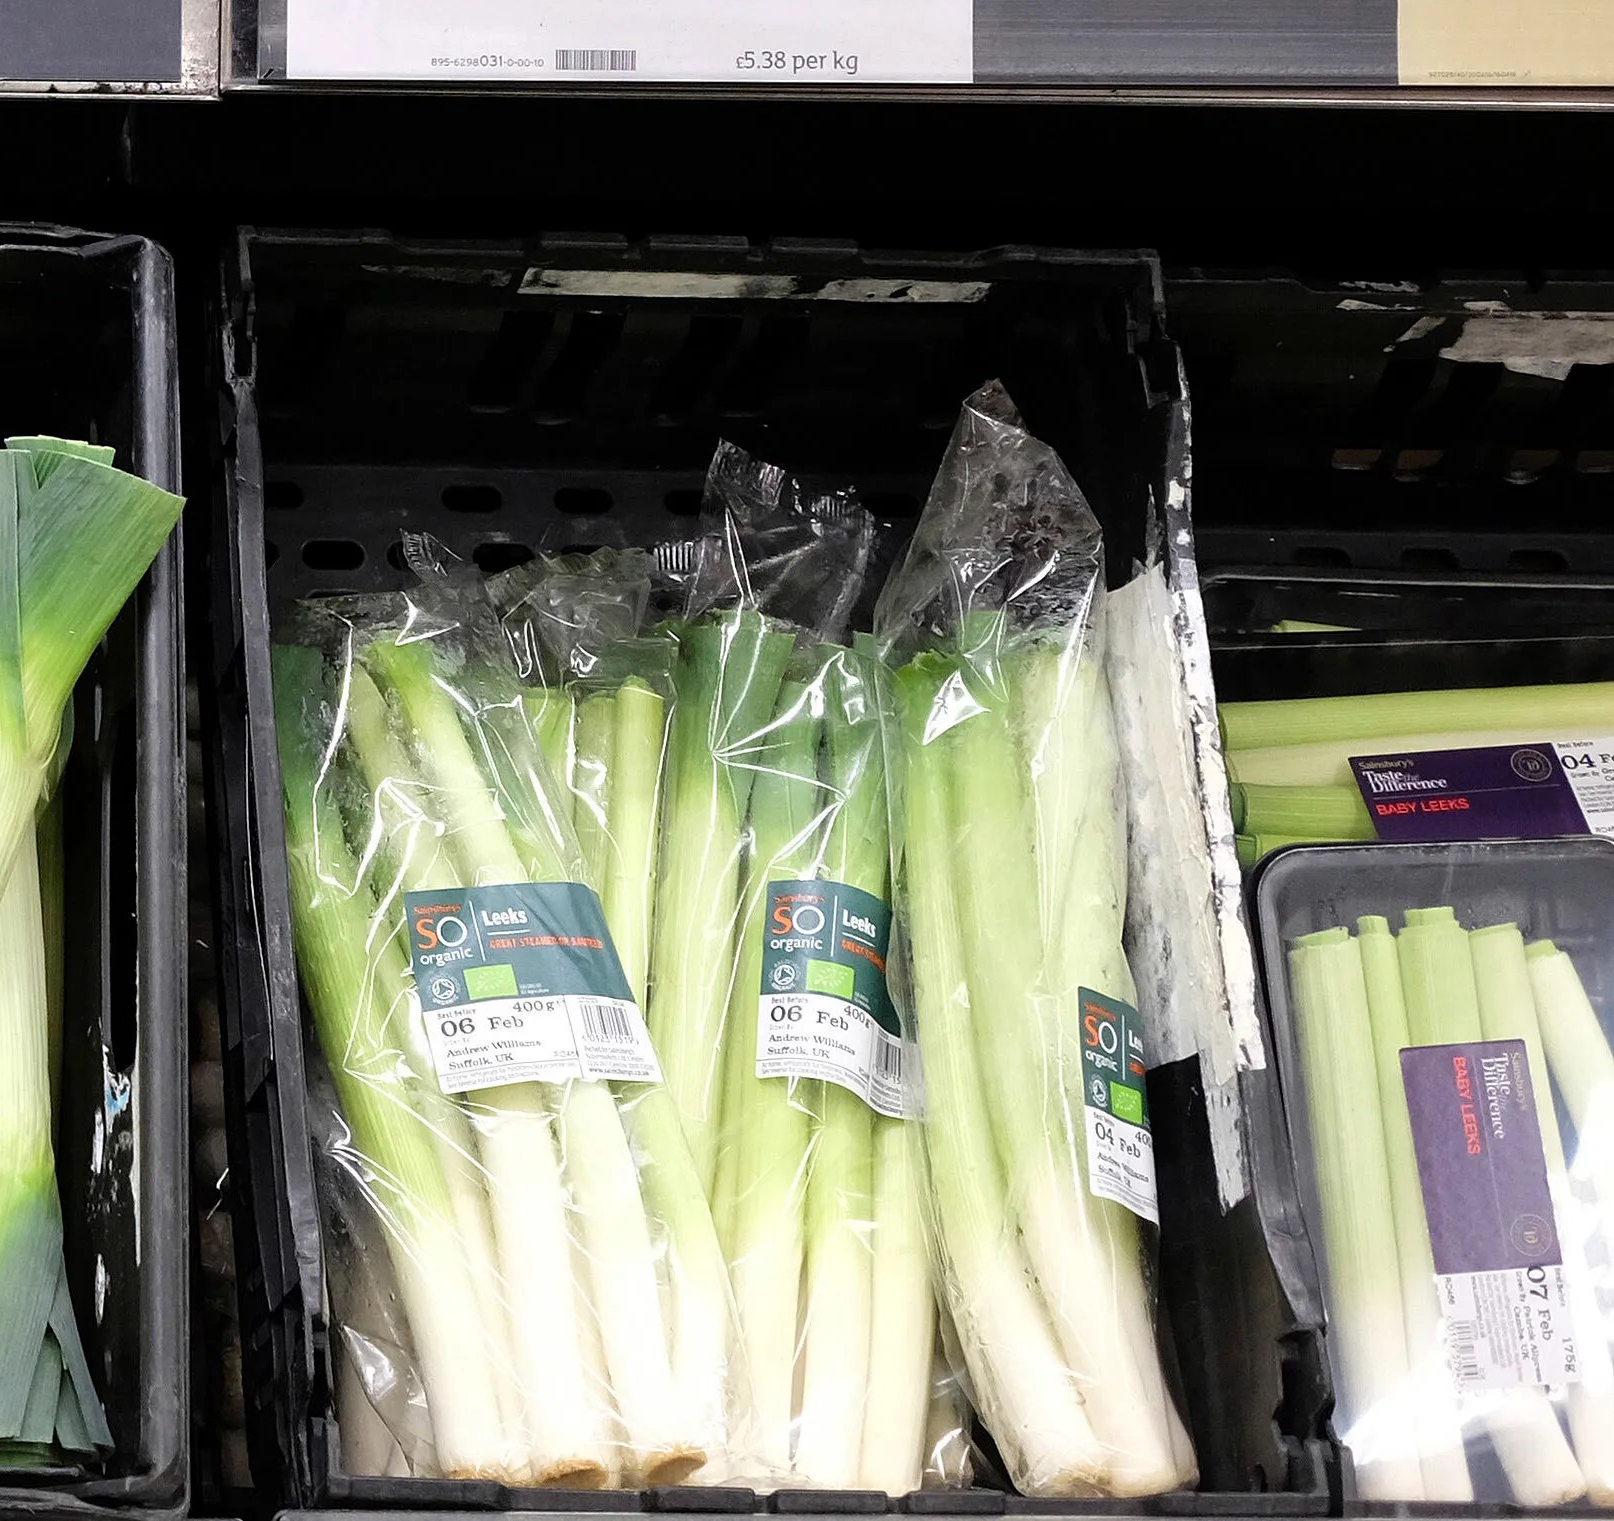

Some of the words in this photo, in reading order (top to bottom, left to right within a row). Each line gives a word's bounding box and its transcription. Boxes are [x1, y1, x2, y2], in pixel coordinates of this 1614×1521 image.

[736, 51, 786, 70] £5.38
[792, 53, 827, 74] per
[832, 50, 859, 75] kg
[1358, 758, 1415, 771] Sainsbury's
[1561, 752, 1597, 771] 04
[1361, 770, 1405, 784] Taste
[1370, 777, 1448, 795] Difference
[1375, 802, 1417, 816] BABY
[1421, 797, 1471, 813] LEEKS
[481, 907, 528, 927] Leeks
[772, 905, 826, 936] SO
[842, 908, 876, 939] Leeks
[416, 915, 468, 951] SO
[770, 936, 823, 953] organic
[420, 946, 474, 967] organic
[512, 999, 555, 1014] 400g
[770, 1005, 803, 1023] 06
[816, 1010, 850, 1031] Feb
[440, 1017, 475, 1037] 06
[488, 1016, 524, 1031] Feb
[1084, 1013, 1118, 1055] SO
[446, 1043, 491, 1059] Andrew
[493, 1039, 542, 1051] Williams
[768, 1033, 810, 1043] Andrew
[813, 1035, 856, 1056] Williams
[812, 1048, 831, 1059] UK
[495, 1052, 514, 1064] UK
[1085, 1049, 1118, 1073] organic
[1452, 1055, 1473, 1104] BABY
[1496, 1052, 1511, 1096] Taste
[1480, 1057, 1506, 1140] Difference
[1095, 1122, 1114, 1146] 04
[1119, 1137, 1142, 1160] Feb
[1460, 1103, 1482, 1156] LEEKS
[1526, 1264, 1549, 1301] 07
[1537, 1308, 1554, 1341] Feb
